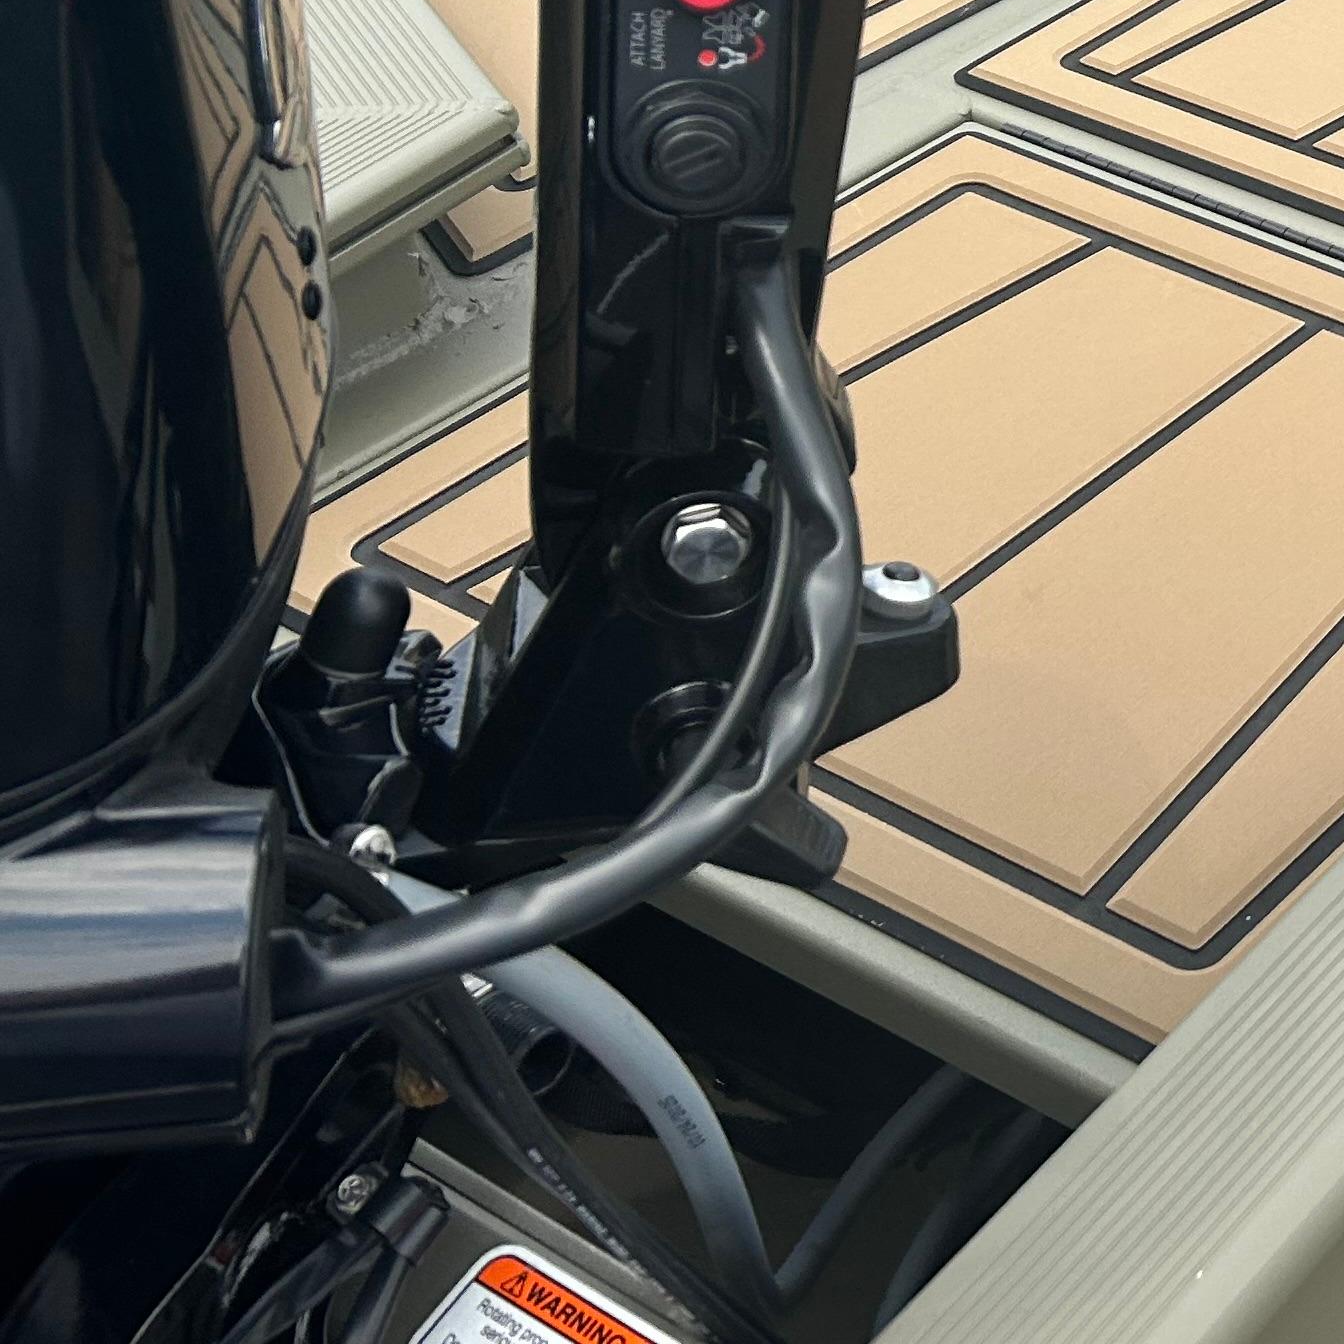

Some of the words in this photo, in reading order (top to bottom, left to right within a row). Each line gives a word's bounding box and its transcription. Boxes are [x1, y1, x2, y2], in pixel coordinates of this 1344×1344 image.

[629, 11, 647, 66] ATTACH
[650, 8, 666, 71] LANYARD
[476, 1298, 522, 1338] Rotating
